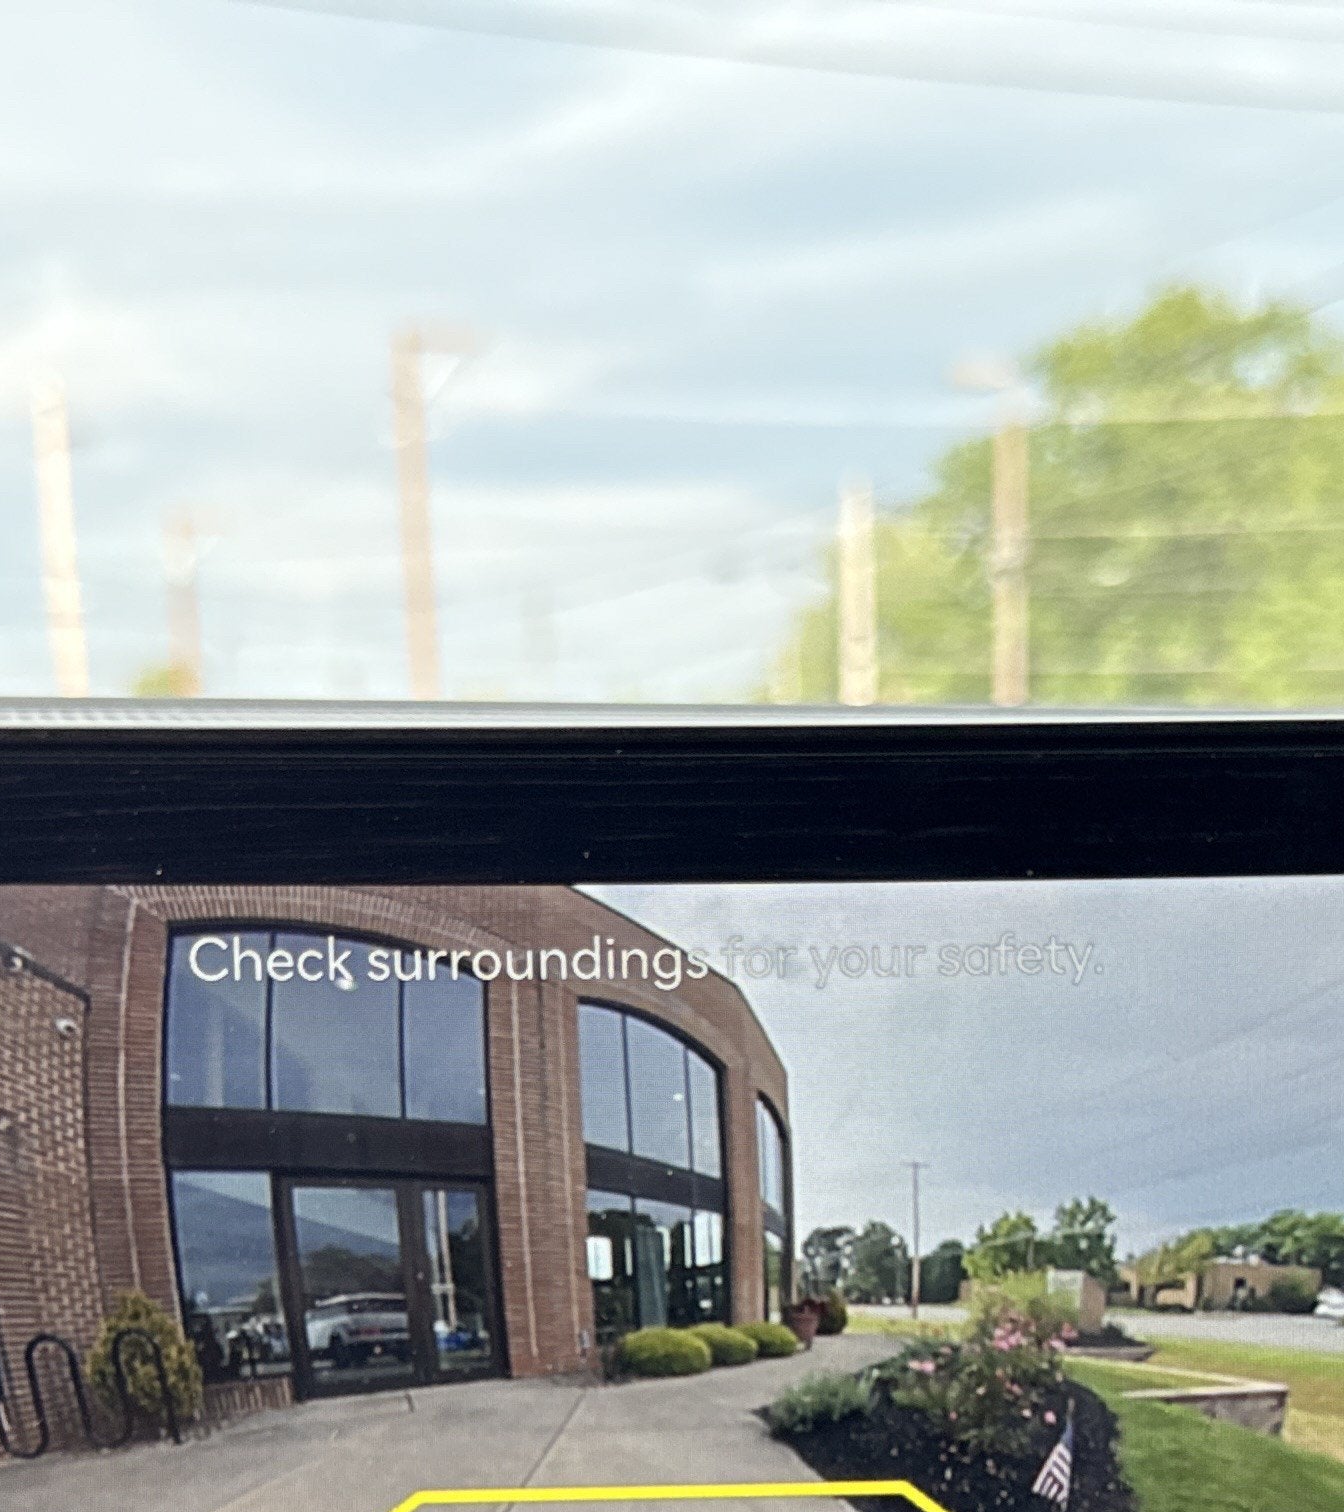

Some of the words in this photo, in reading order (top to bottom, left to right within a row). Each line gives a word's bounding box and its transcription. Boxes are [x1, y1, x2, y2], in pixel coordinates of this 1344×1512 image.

[189, 935, 354, 982] Check
[367, 935, 709, 990] surroundings
[722, 934, 797, 978] for
[808, 943, 927, 990] your
[938, 931, 1104, 986] safety.
